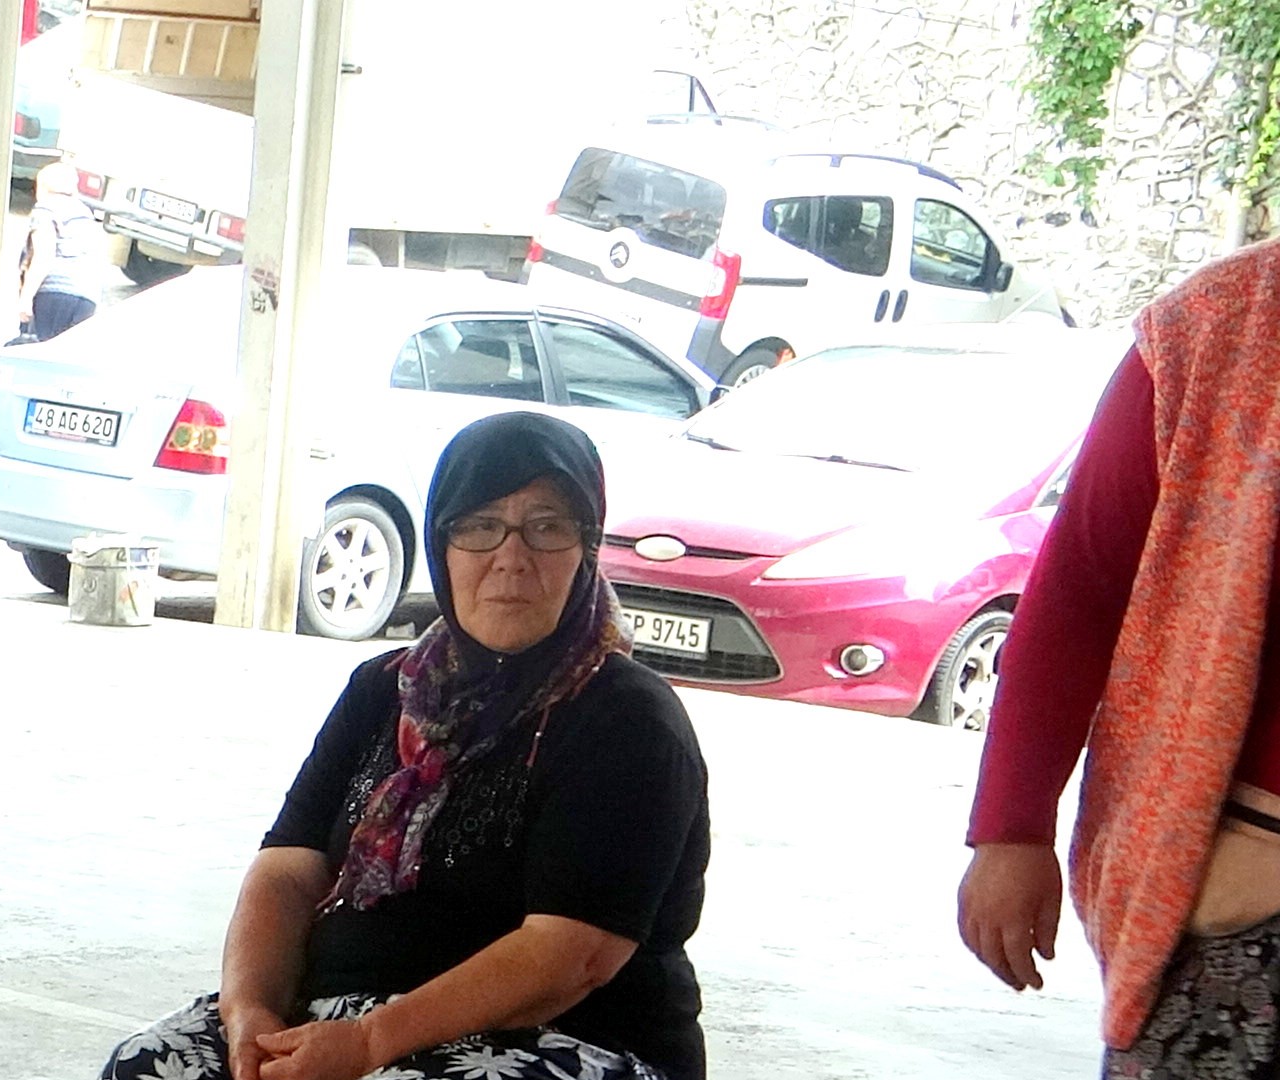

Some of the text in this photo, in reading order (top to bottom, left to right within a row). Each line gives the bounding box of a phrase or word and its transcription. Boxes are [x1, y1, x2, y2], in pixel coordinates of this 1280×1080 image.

[35, 407, 113, 437] 48 AG 620
[623, 612, 700, 648] P 9745
